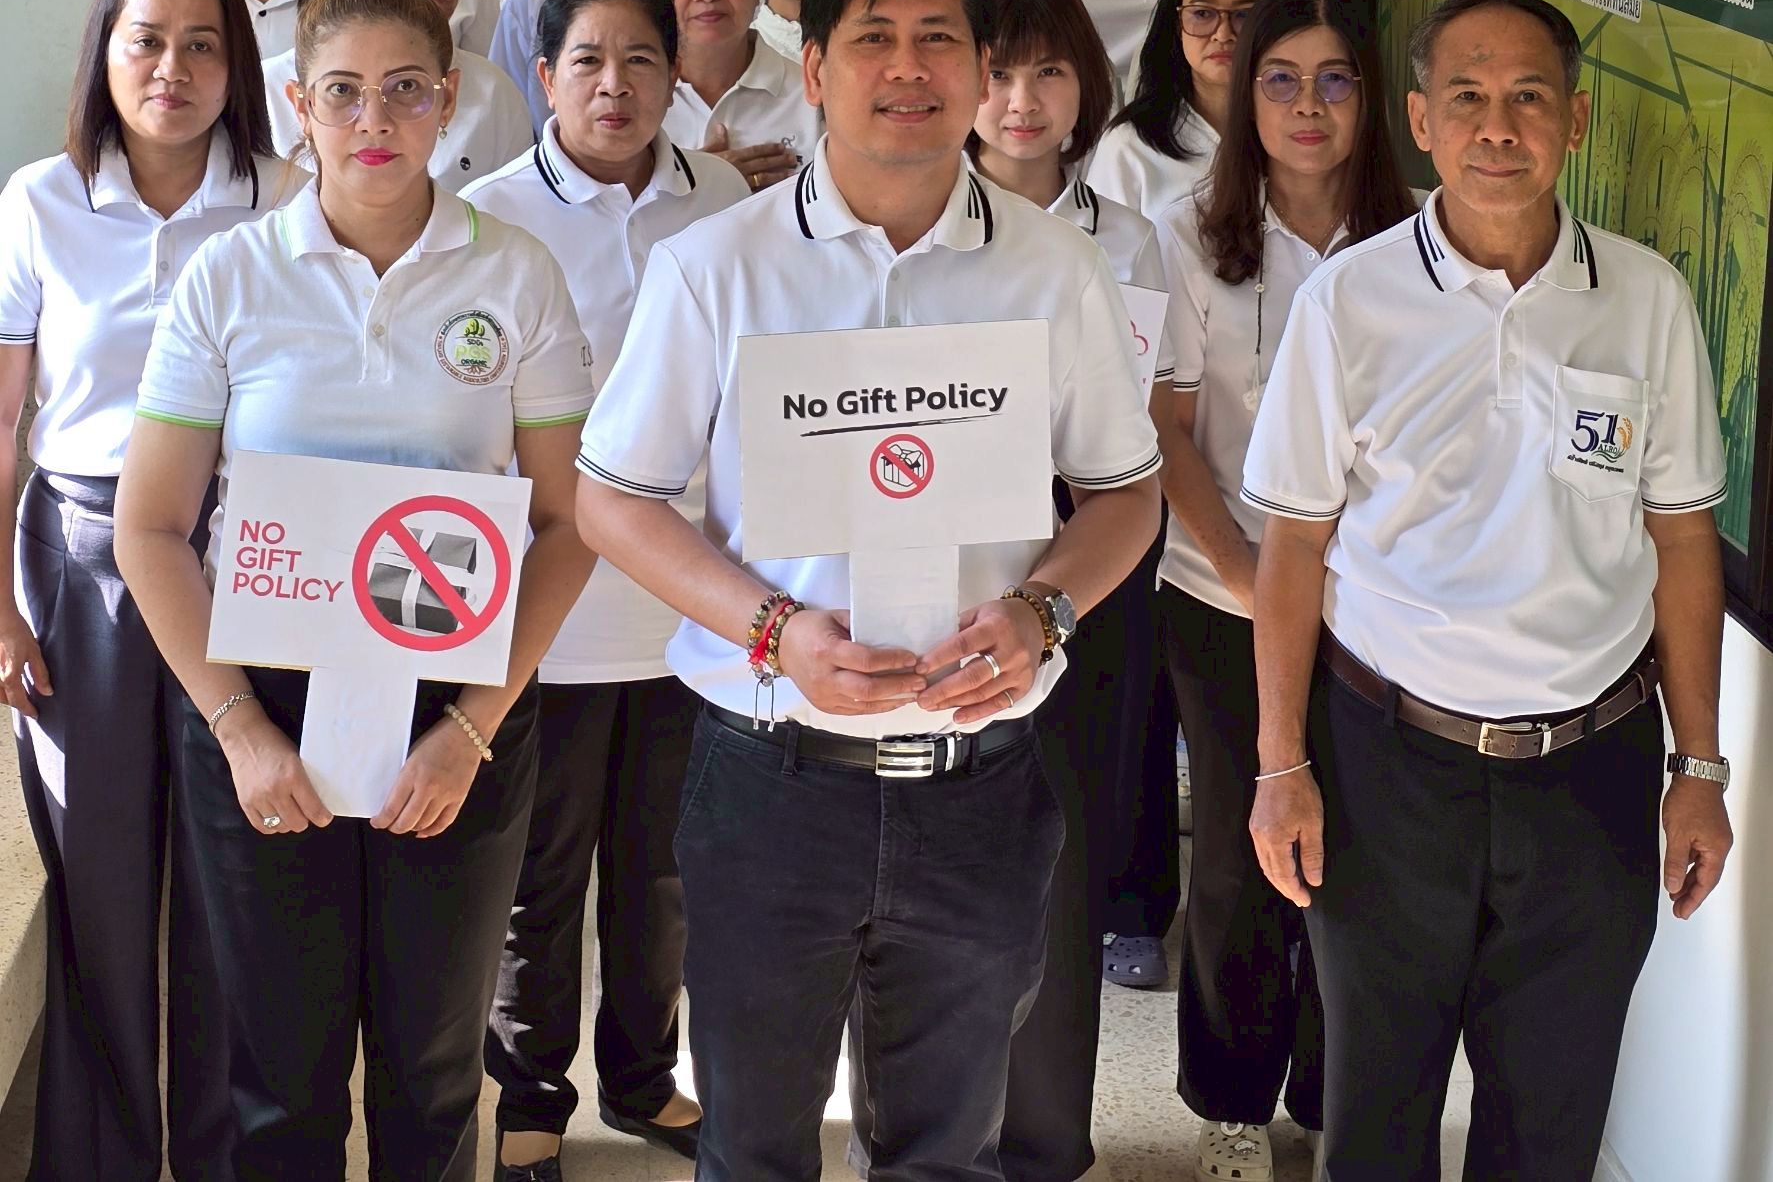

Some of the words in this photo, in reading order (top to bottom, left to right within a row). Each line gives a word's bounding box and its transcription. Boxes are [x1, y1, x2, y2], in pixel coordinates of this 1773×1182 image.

[783, 393, 828, 420] No
[836, 387, 897, 415] Gift
[905, 383, 1008, 412] Policy
[1570, 409, 1619, 453] 51
[239, 519, 286, 545] NO
[236, 546, 303, 573] GIFT
[232, 572, 344, 603] POLICY
